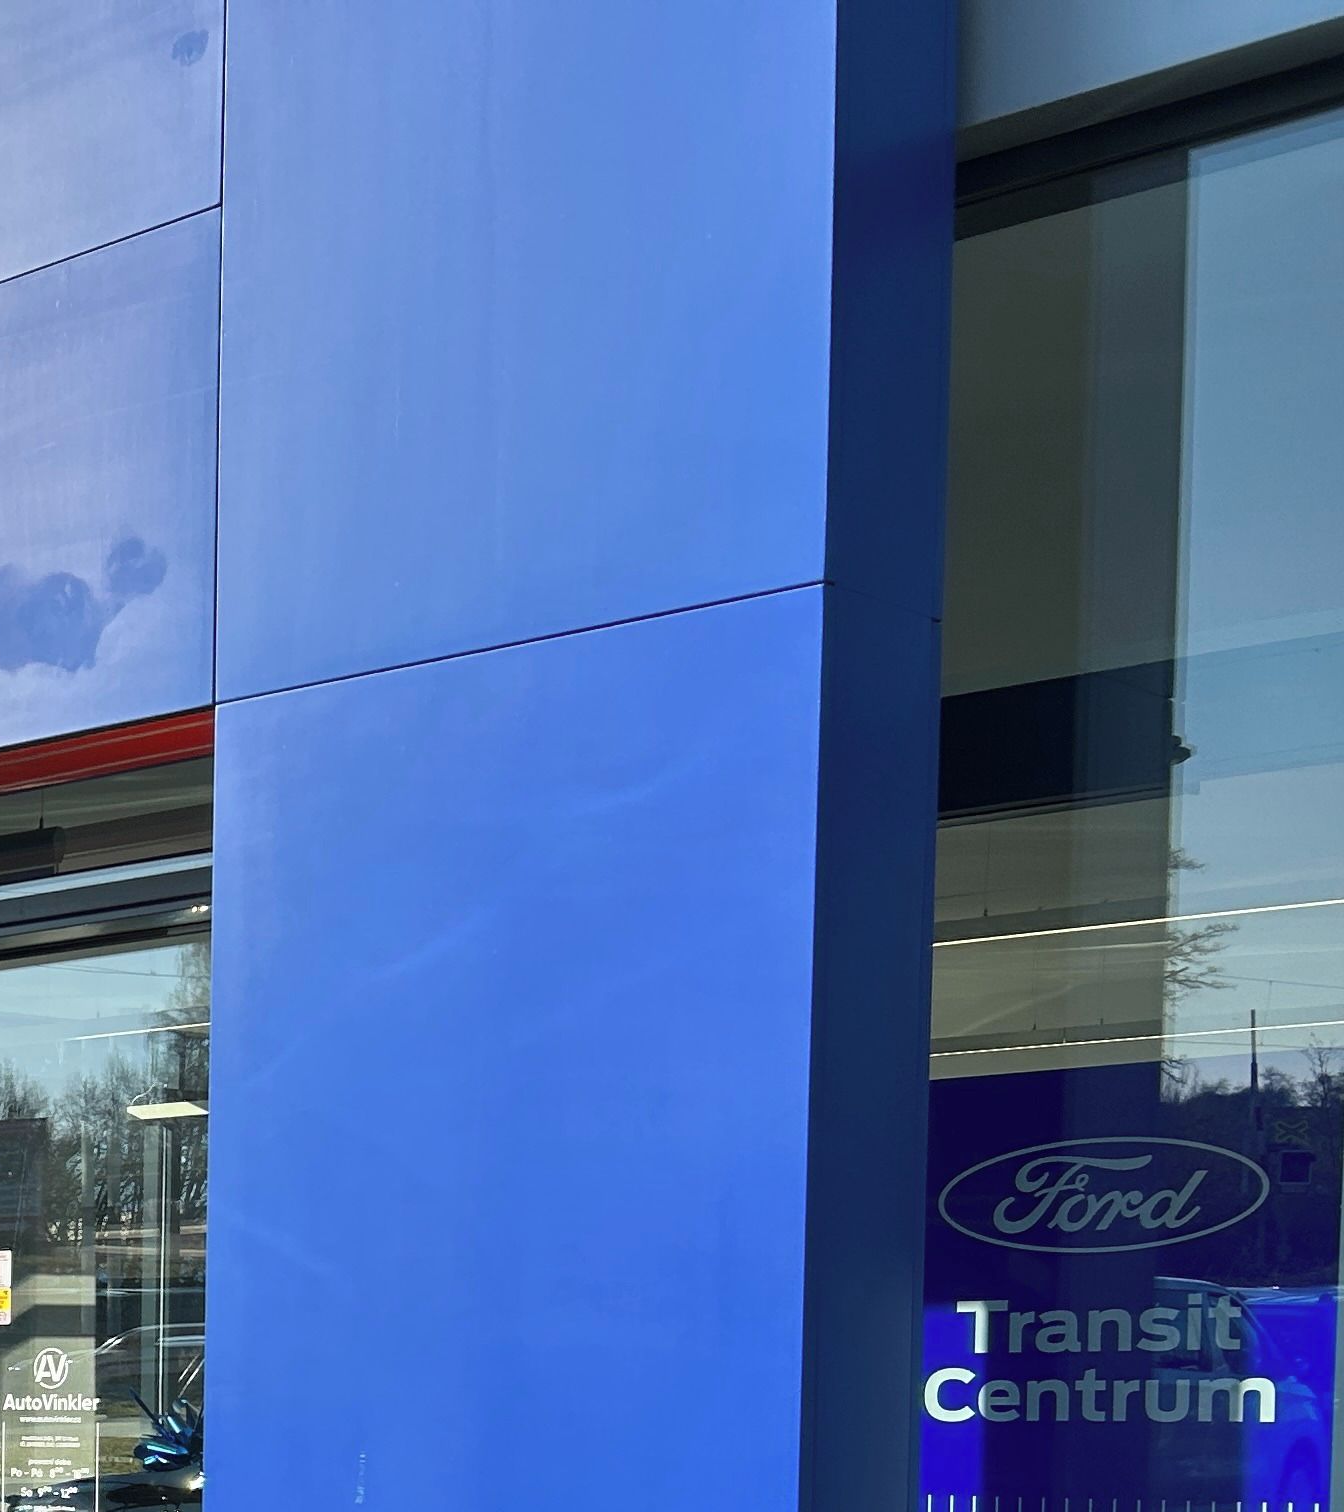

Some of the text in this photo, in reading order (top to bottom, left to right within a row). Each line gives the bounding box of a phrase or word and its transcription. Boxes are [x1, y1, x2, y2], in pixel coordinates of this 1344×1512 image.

[992, 1153, 1209, 1235] Ford
[956, 1292, 1243, 1354] Transit
[35, 1354, 68, 1383] AV
[923, 1367, 1276, 1423] Centrum
[2, 1392, 101, 1411] AutoVinkler
